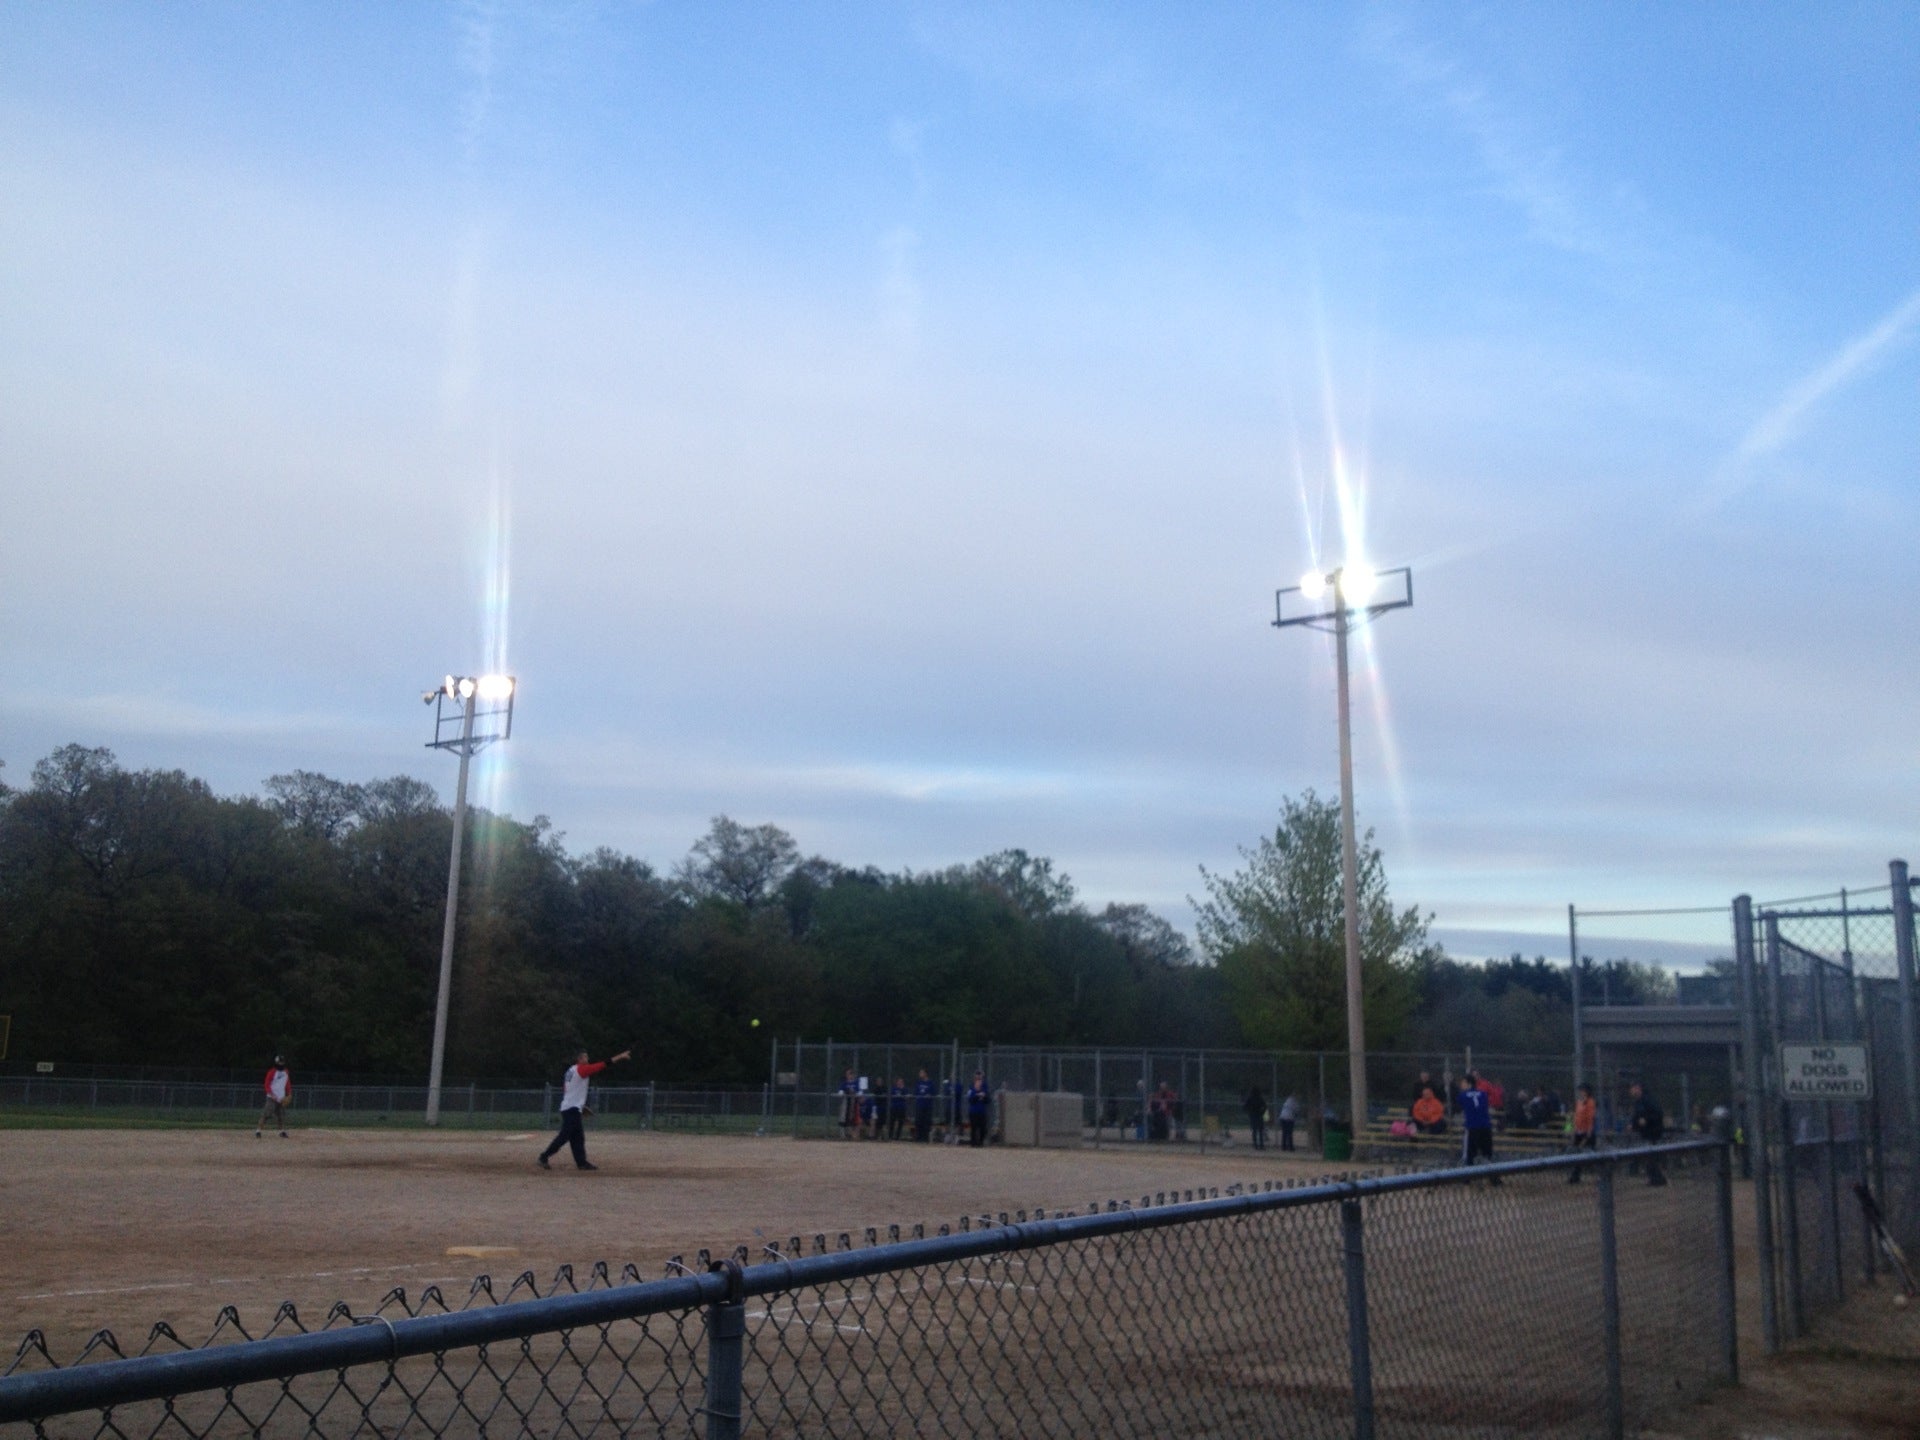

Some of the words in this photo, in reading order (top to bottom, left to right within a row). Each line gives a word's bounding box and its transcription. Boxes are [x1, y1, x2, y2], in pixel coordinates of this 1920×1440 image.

[1811, 1048, 1836, 1061] NO
[1802, 1063, 1849, 1077] DOGS
[1789, 1080, 1865, 1092] ALLOWED
